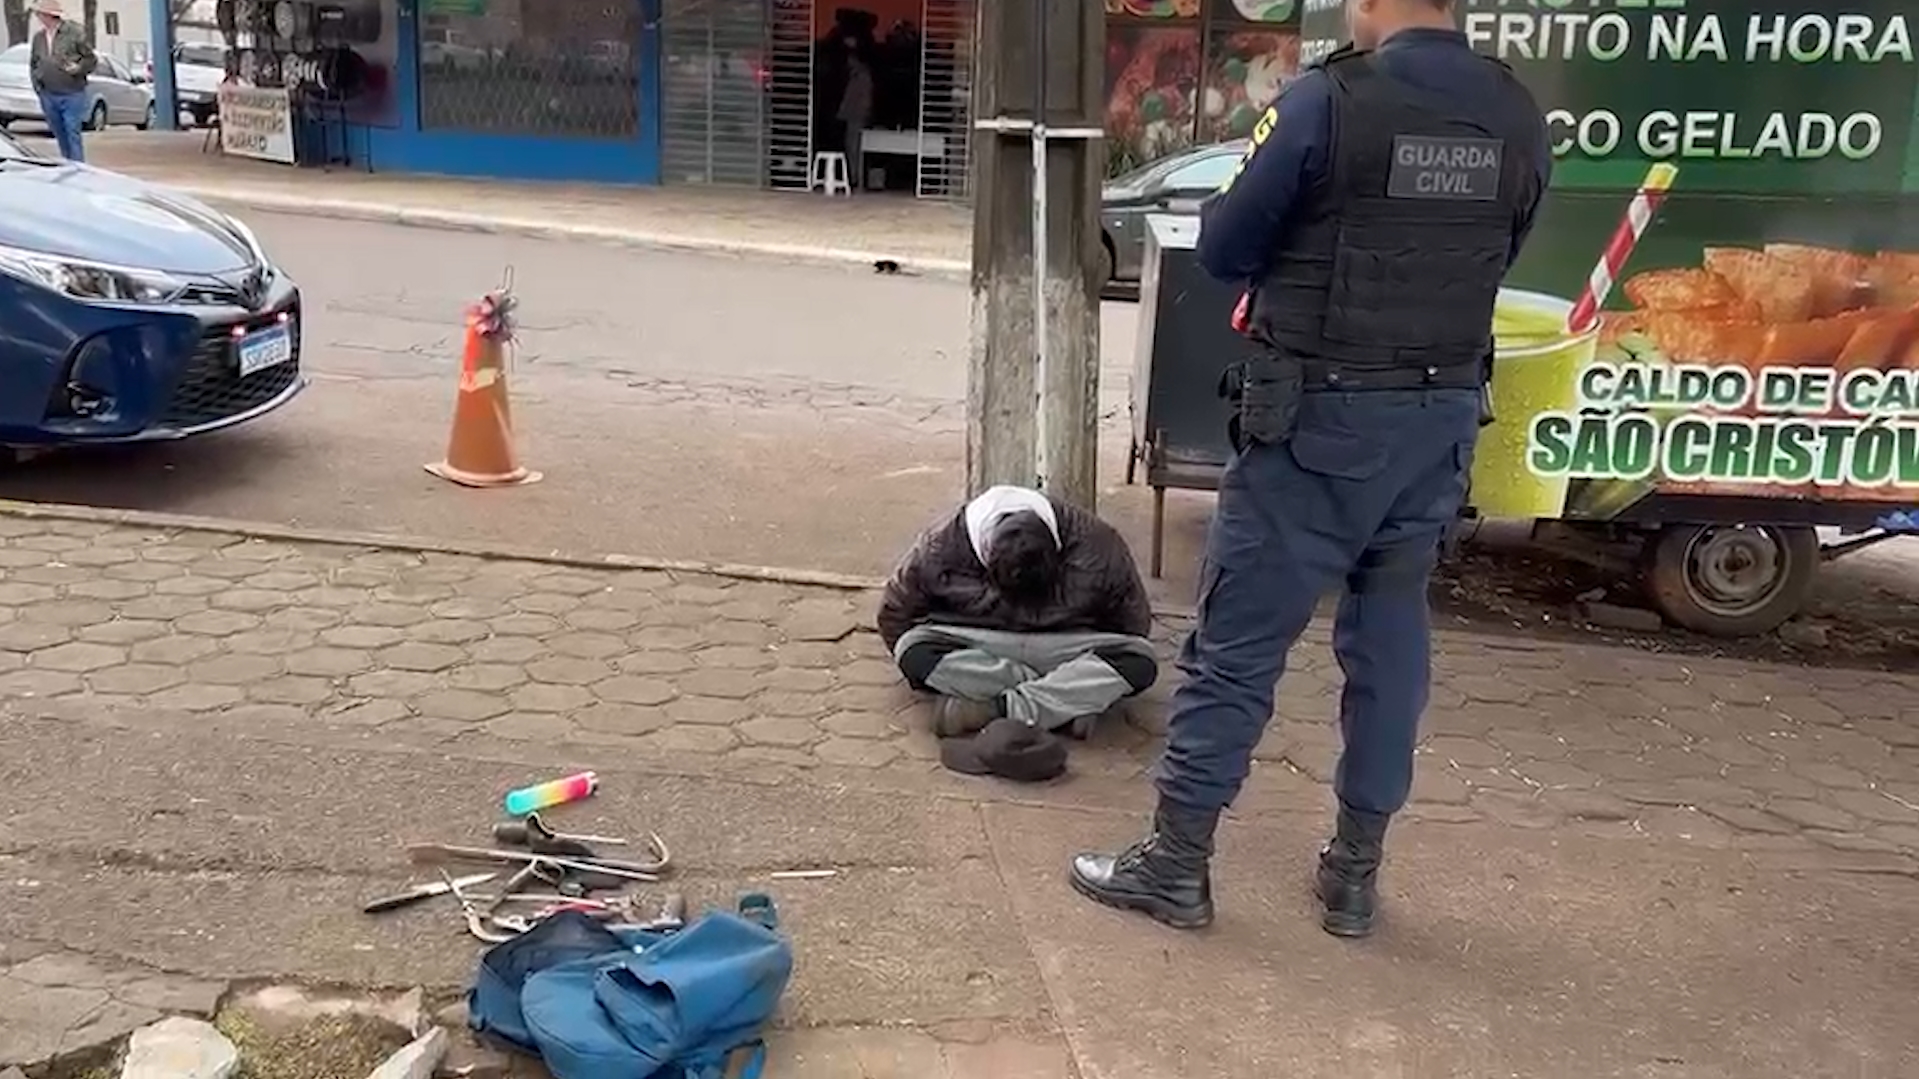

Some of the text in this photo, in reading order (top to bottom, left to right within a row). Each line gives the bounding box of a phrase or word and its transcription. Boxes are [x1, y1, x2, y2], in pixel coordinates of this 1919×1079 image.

[1464, 13, 1914, 62] FRITO NA HORA
[1398, 144, 1497, 169] GUARDA
[1636, 110, 1882, 160] GELADO
[1416, 171, 1474, 194] CIVIL
[1580, 366, 1919, 411] CALDO DE CA
[1531, 406, 1655, 475] SÃO
